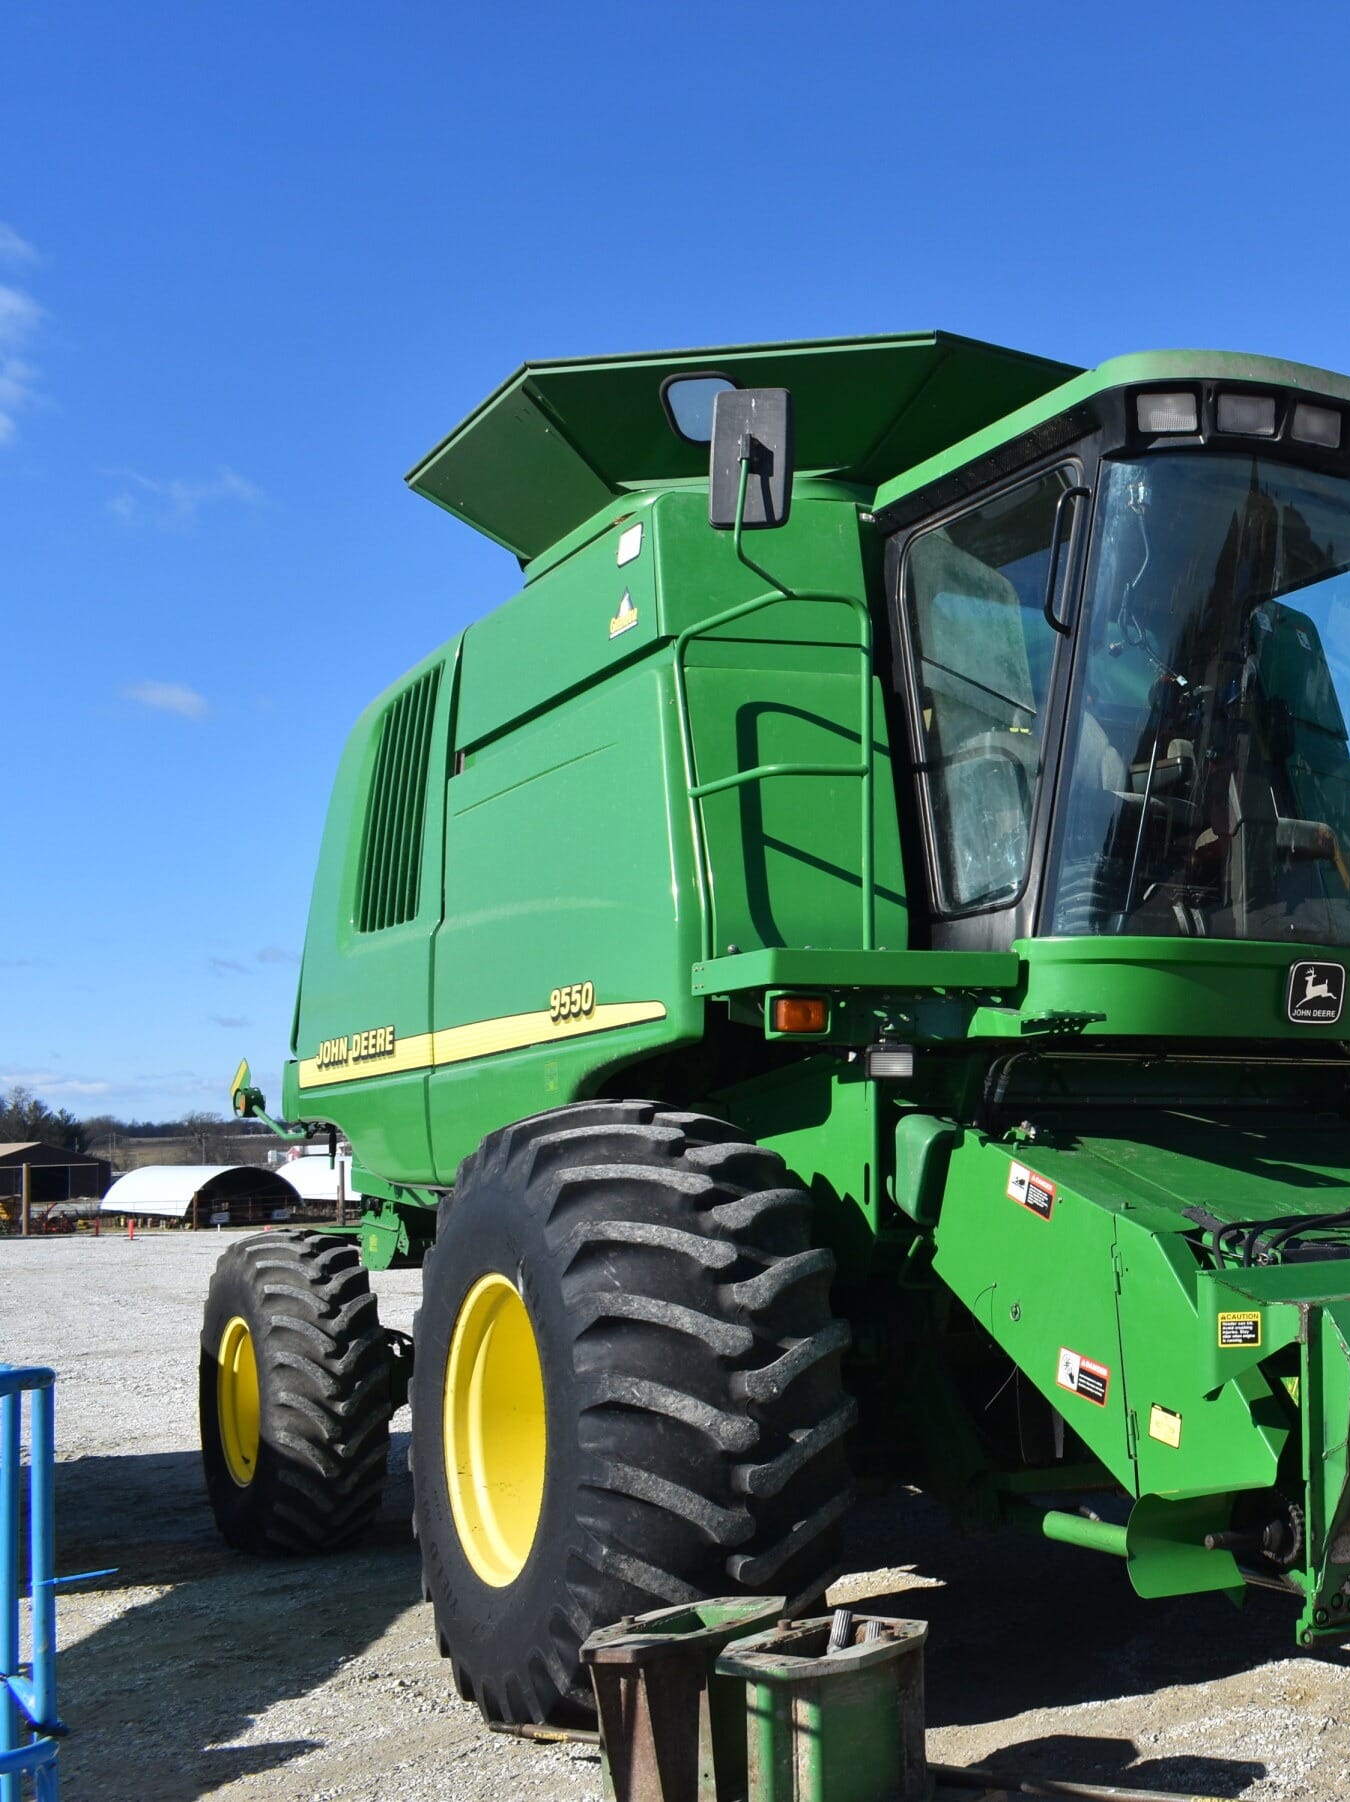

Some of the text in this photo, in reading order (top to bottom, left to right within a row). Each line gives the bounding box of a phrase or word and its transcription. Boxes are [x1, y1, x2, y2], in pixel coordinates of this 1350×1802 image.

[550, 980, 594, 1022] 9550
[1292, 1009, 1336, 1018] JOHN DEERE
[315, 1025, 395, 1069] JOHN DEERE
